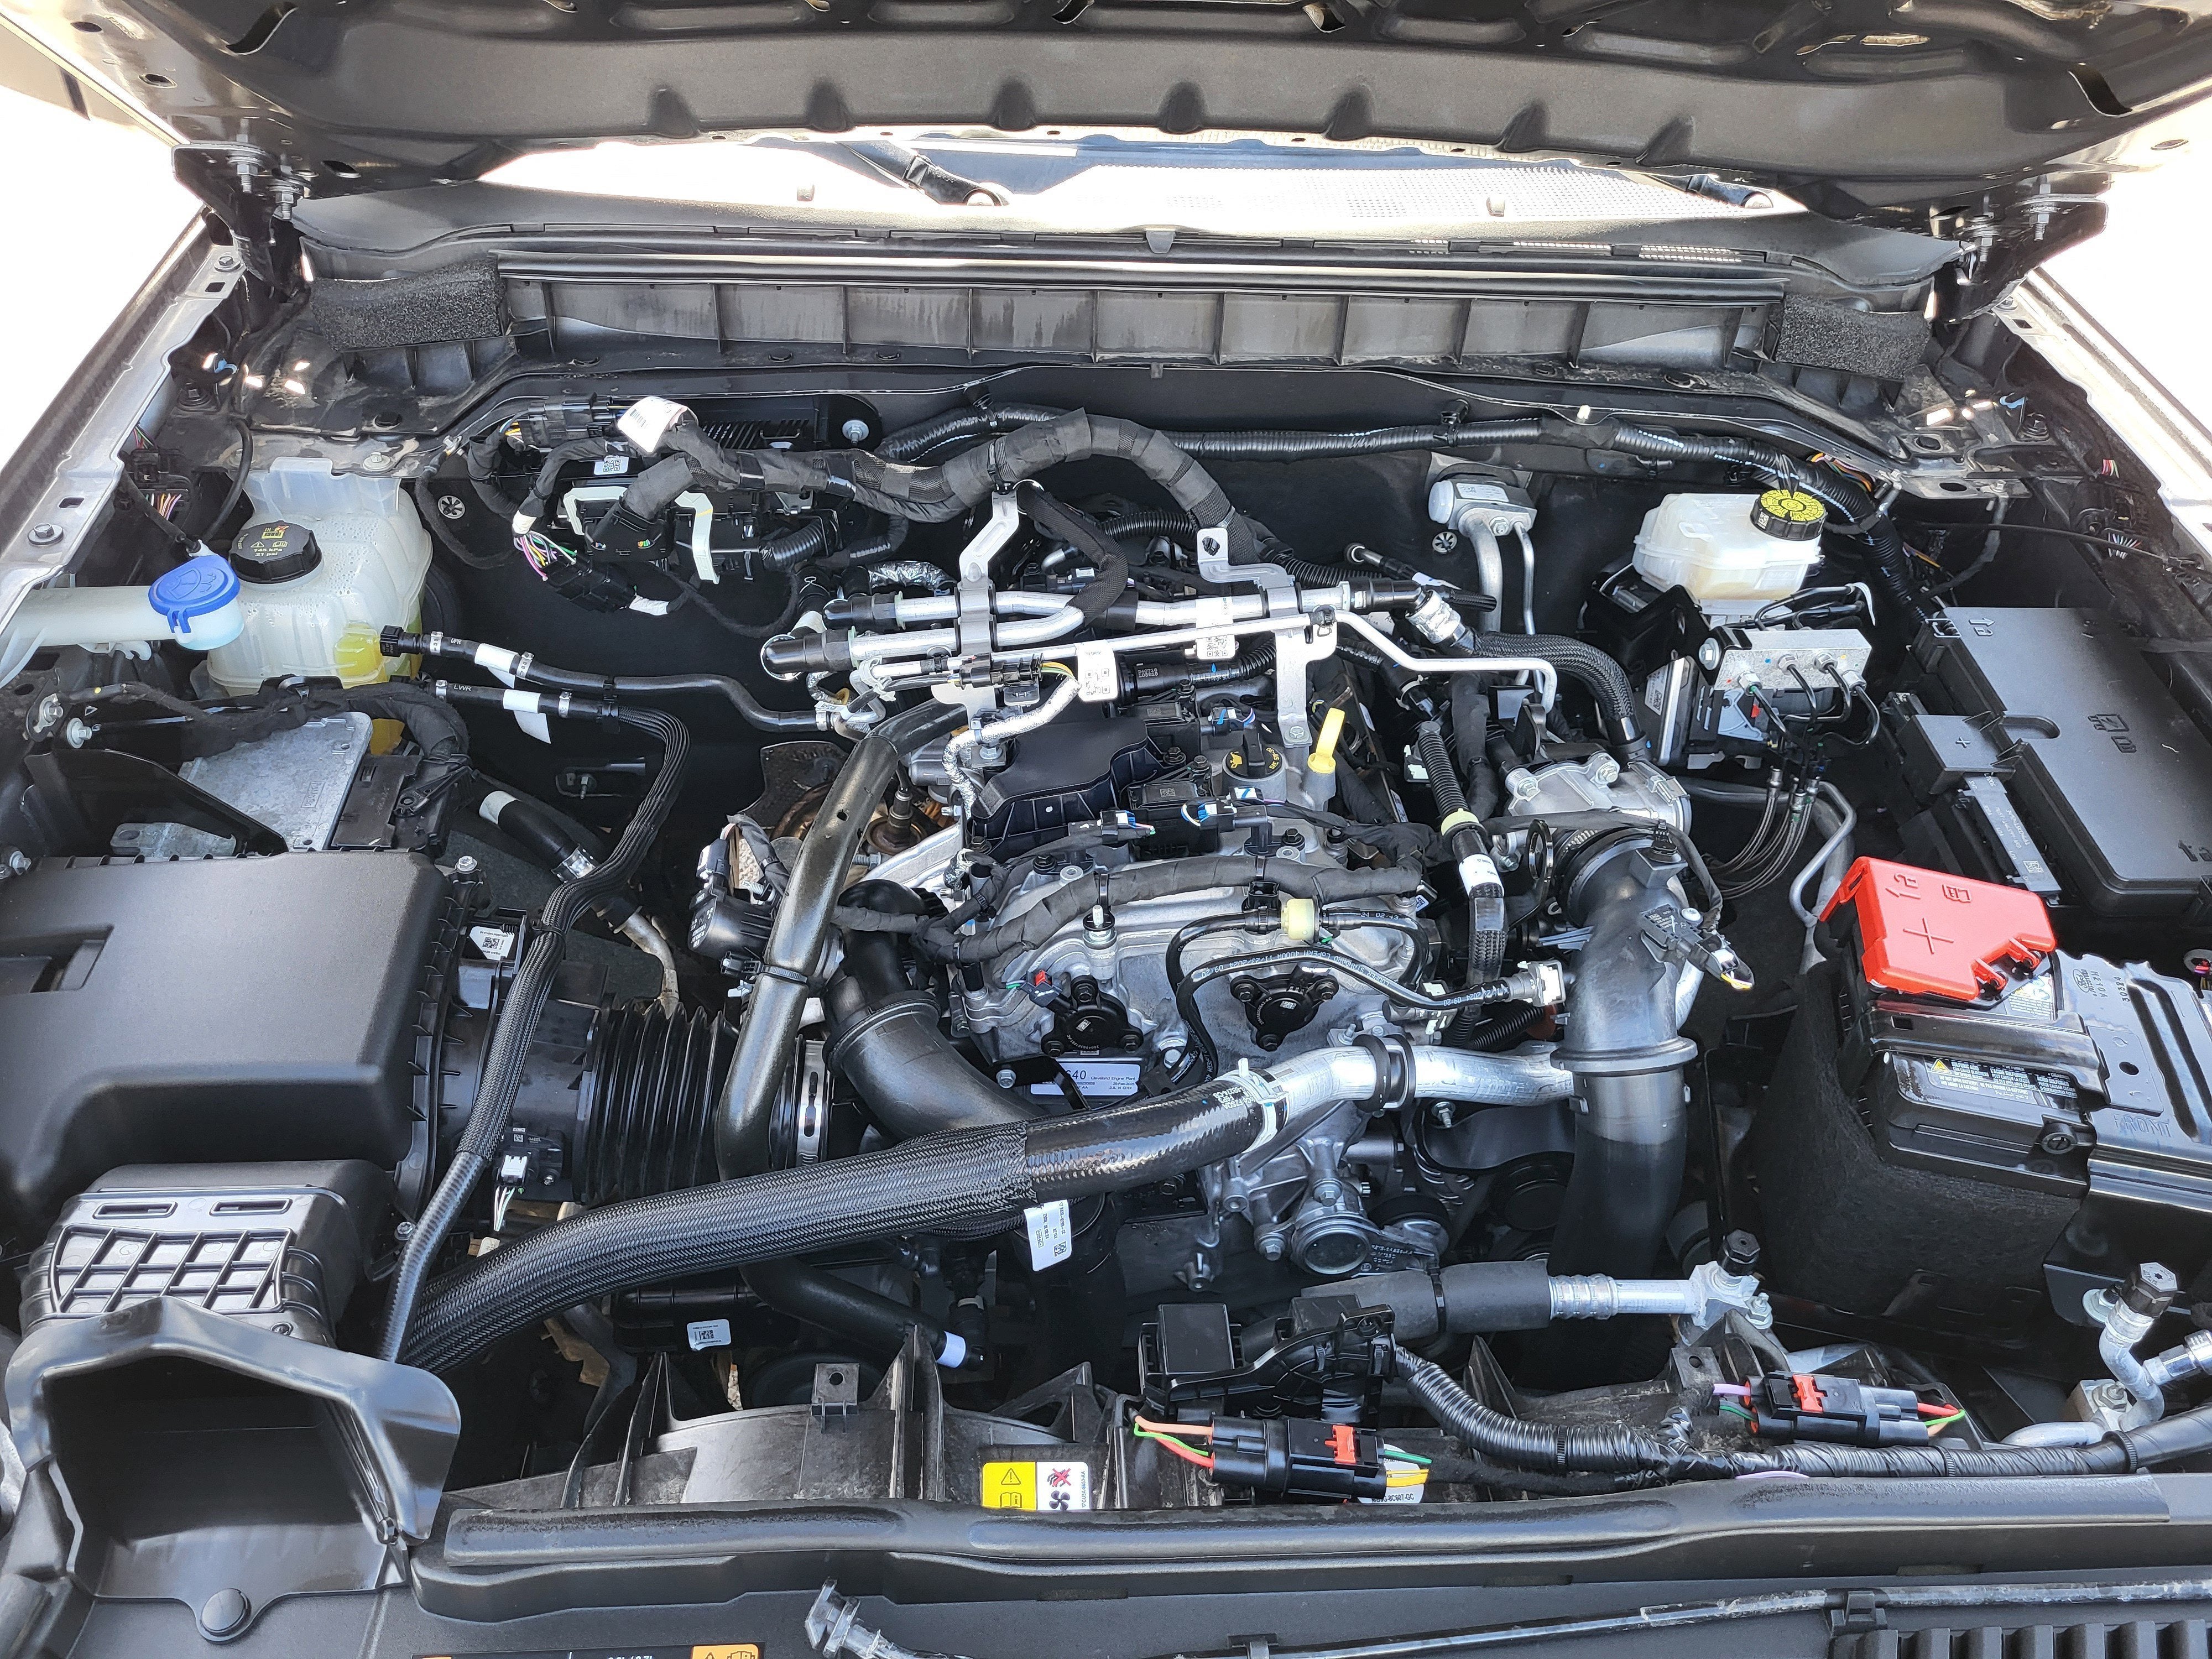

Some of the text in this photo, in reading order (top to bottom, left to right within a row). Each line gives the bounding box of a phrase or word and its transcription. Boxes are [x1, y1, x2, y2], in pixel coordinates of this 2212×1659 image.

[450, 637, 462, 645] UPR
[1269, 761, 1279, 769] SAE
[1303, 950, 1331, 959] LoPERM
[1333, 956, 1365, 974] STANDARD
[1443, 996, 1462, 1006] 09:20
[2114, 1113, 2172, 1138] FRONT
